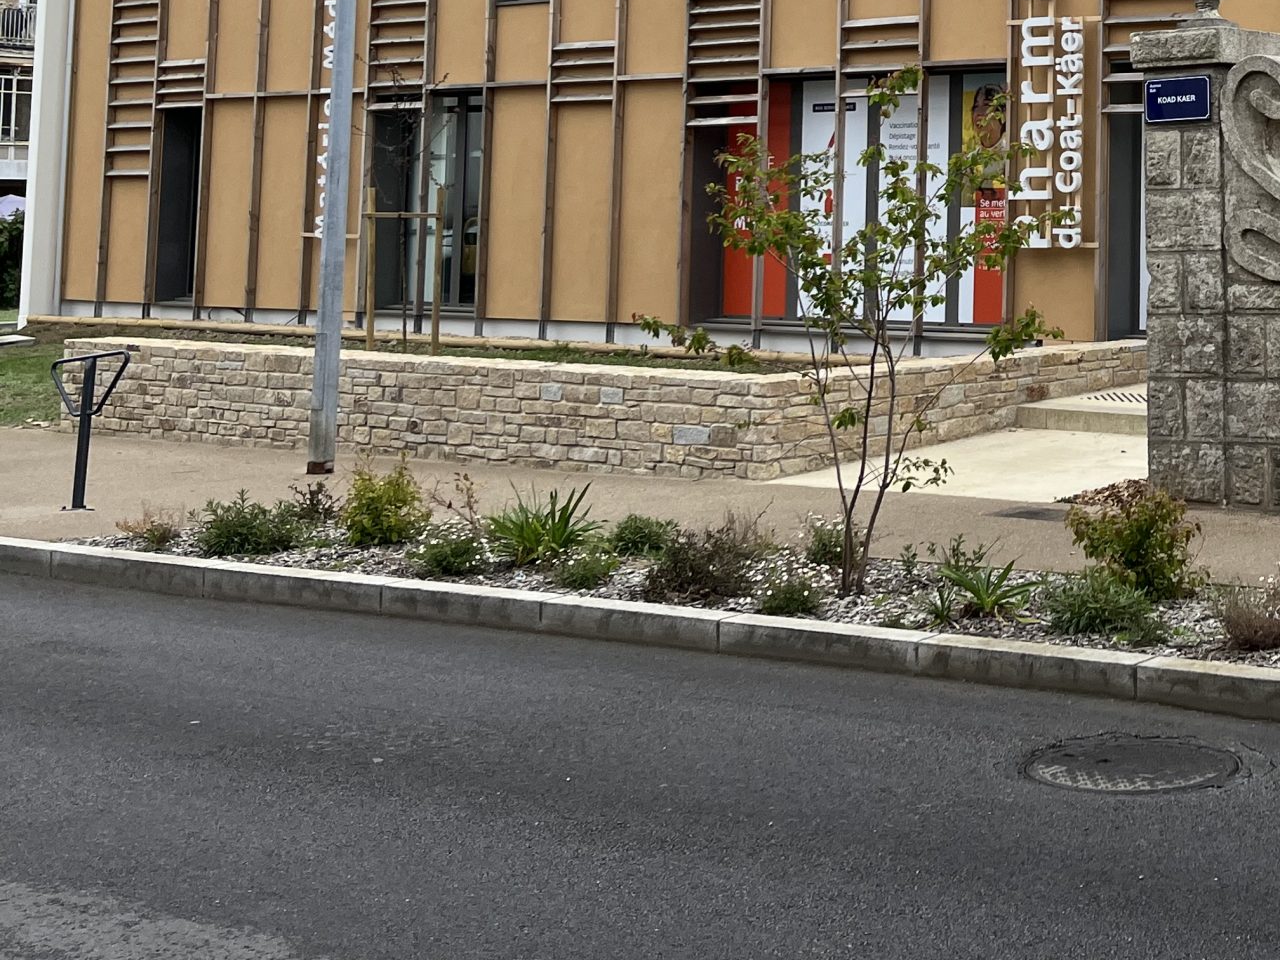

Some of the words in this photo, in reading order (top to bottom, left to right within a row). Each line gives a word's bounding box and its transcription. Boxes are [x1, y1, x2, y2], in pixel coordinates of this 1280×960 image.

[1055, 16, 1084, 194] Coat-Käer
[1157, 96, 1177, 104] KOAD
[1177, 94, 1196, 103] KAER
